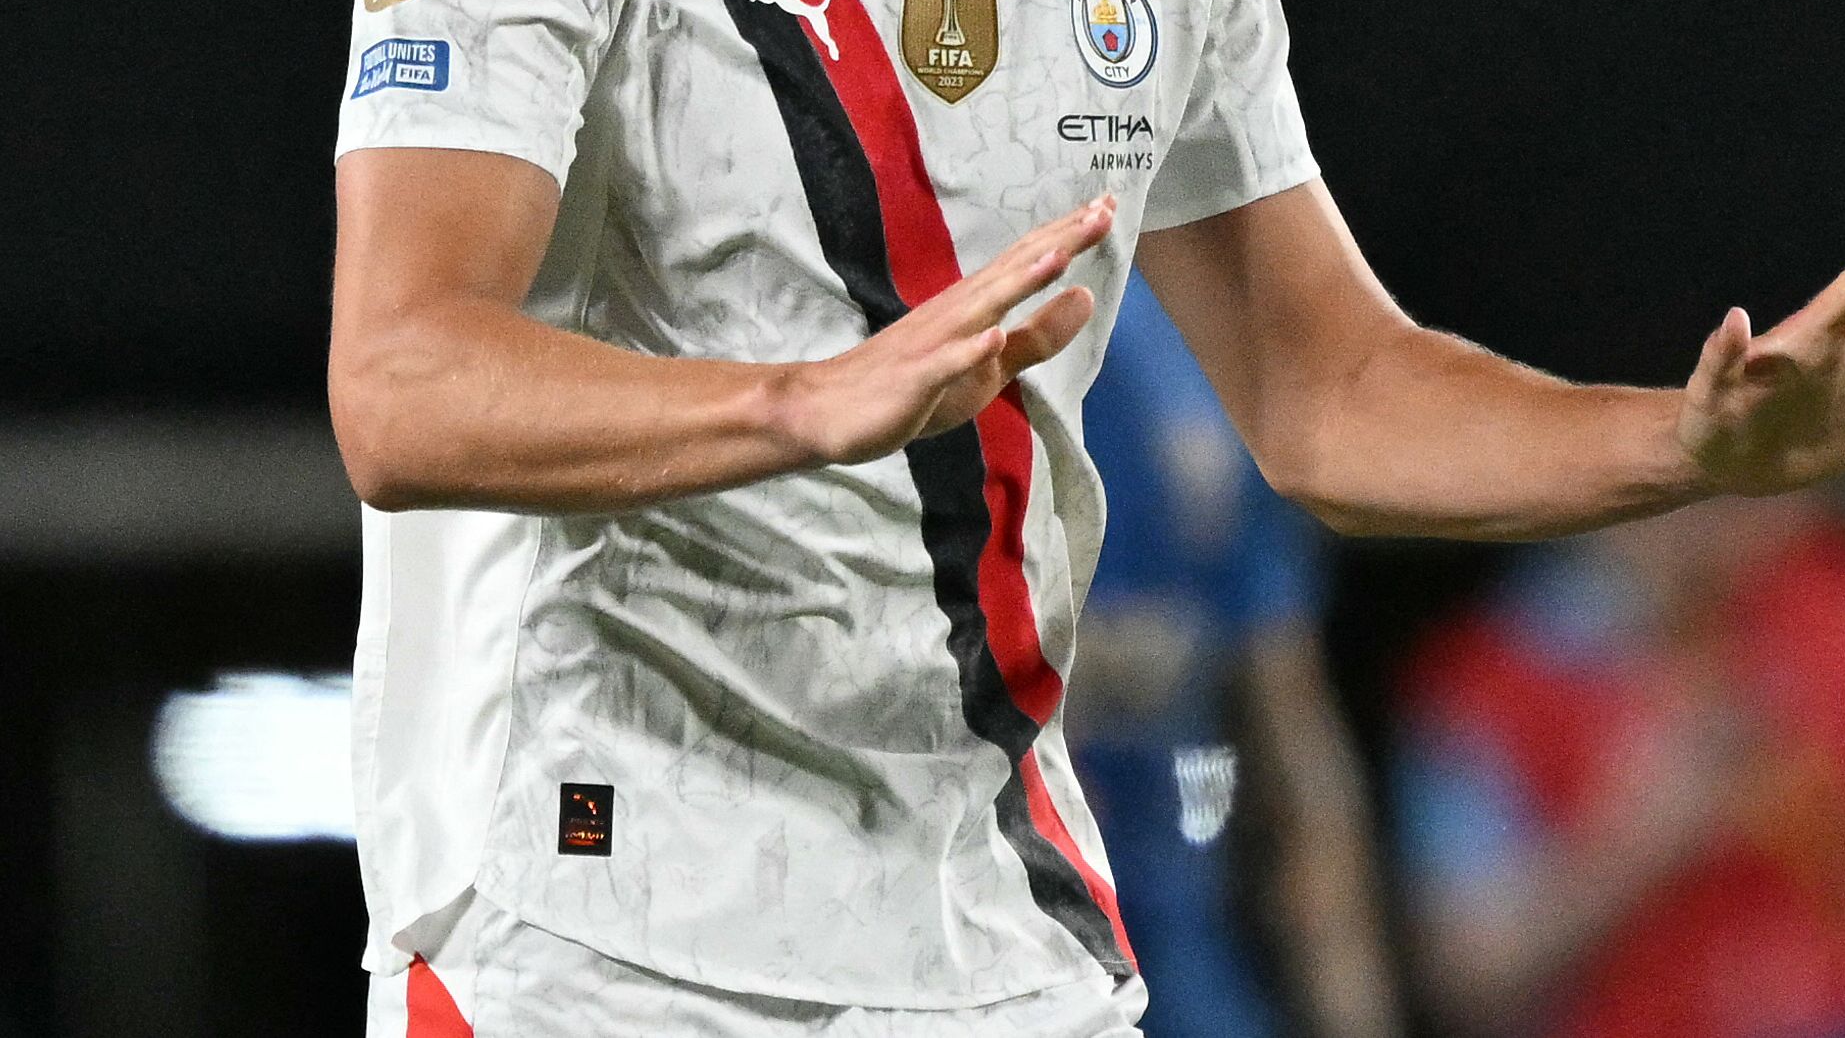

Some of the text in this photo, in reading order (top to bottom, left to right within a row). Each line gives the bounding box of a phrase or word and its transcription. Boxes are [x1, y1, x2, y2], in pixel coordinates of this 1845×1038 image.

[388, 42, 436, 62] UNITES
[928, 48, 974, 68] FIFA
[400, 67, 431, 80] FIFA
[937, 76, 964, 87] 2023
[1104, 65, 1131, 79] CITY
[1057, 114, 1154, 143] ETIHA
[1090, 152, 1153, 171] AIRWAYS
